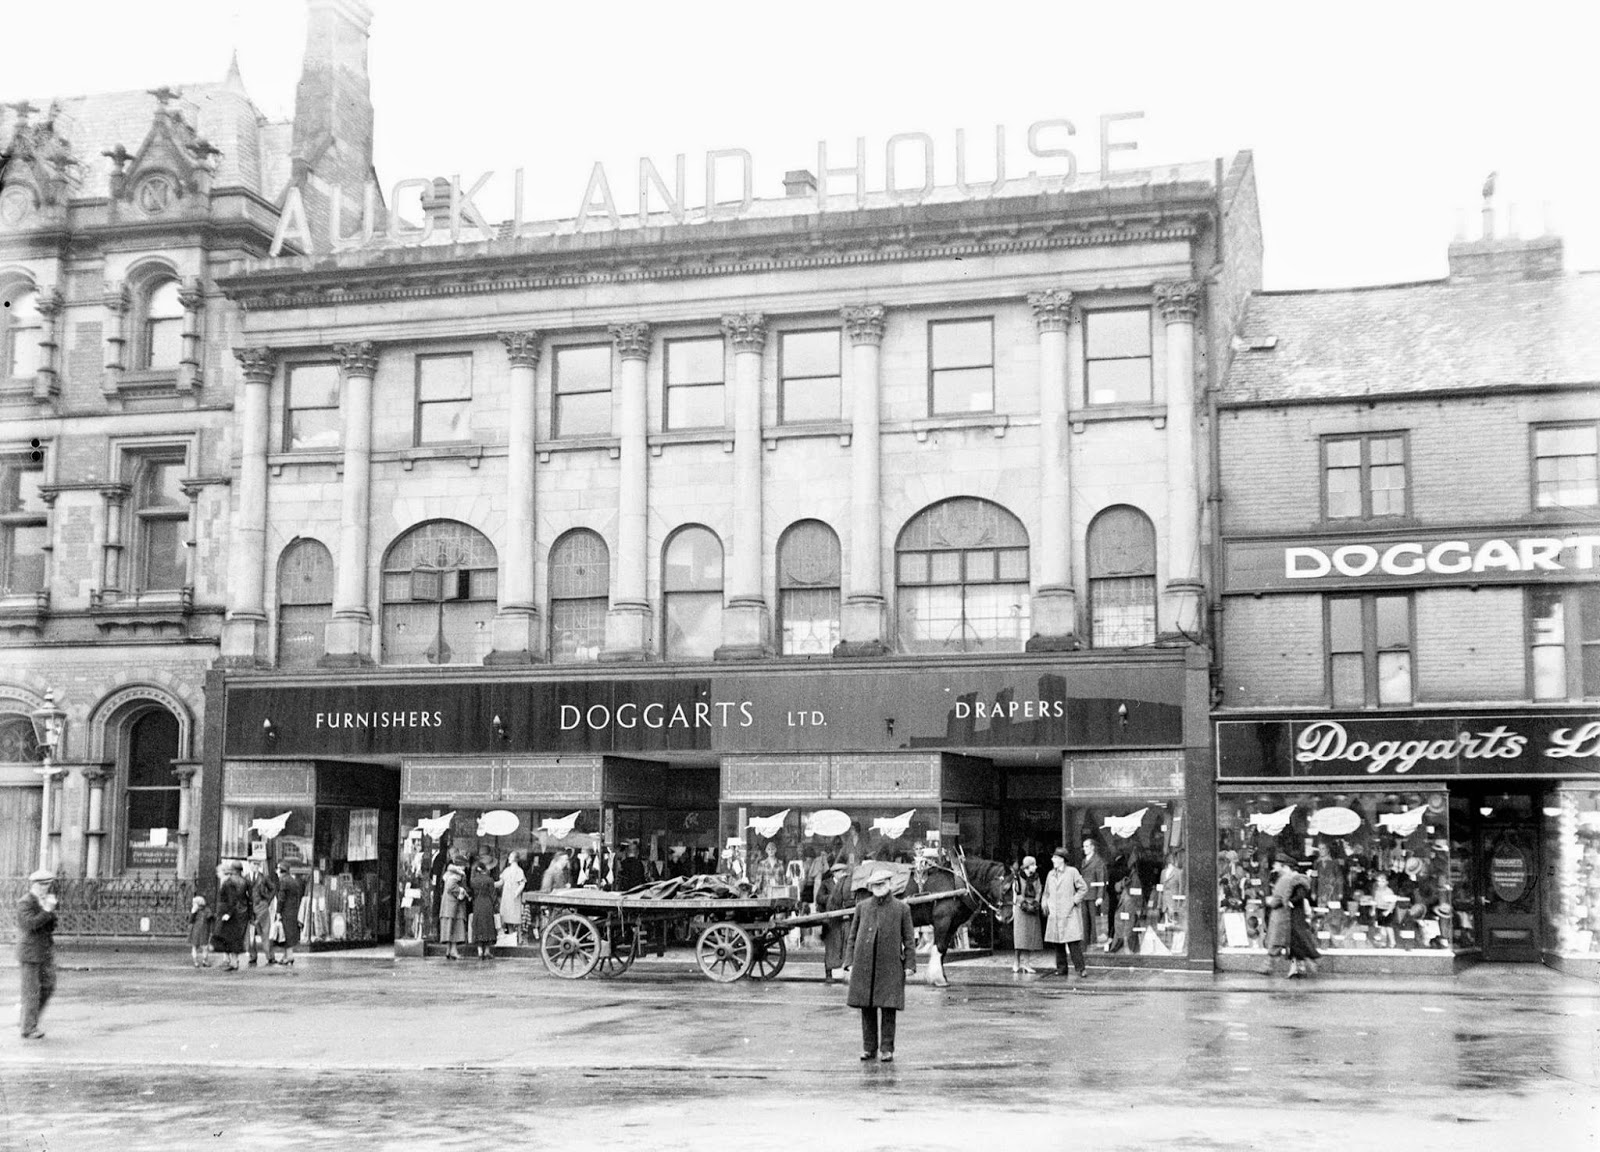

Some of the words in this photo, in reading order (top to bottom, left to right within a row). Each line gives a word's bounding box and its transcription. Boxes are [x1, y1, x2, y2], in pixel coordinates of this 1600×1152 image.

[268, 148, 752, 257] AUCKLAND
[817, 110, 1145, 213] HOUSE
[315, 711, 442, 729] FURNISHERS
[560, 701, 753, 730] DOGGARTS
[787, 710, 827, 727] LTD.
[955, 700, 1064, 719] DRAPERS
[1295, 720, 1528, 774] Doggarts
